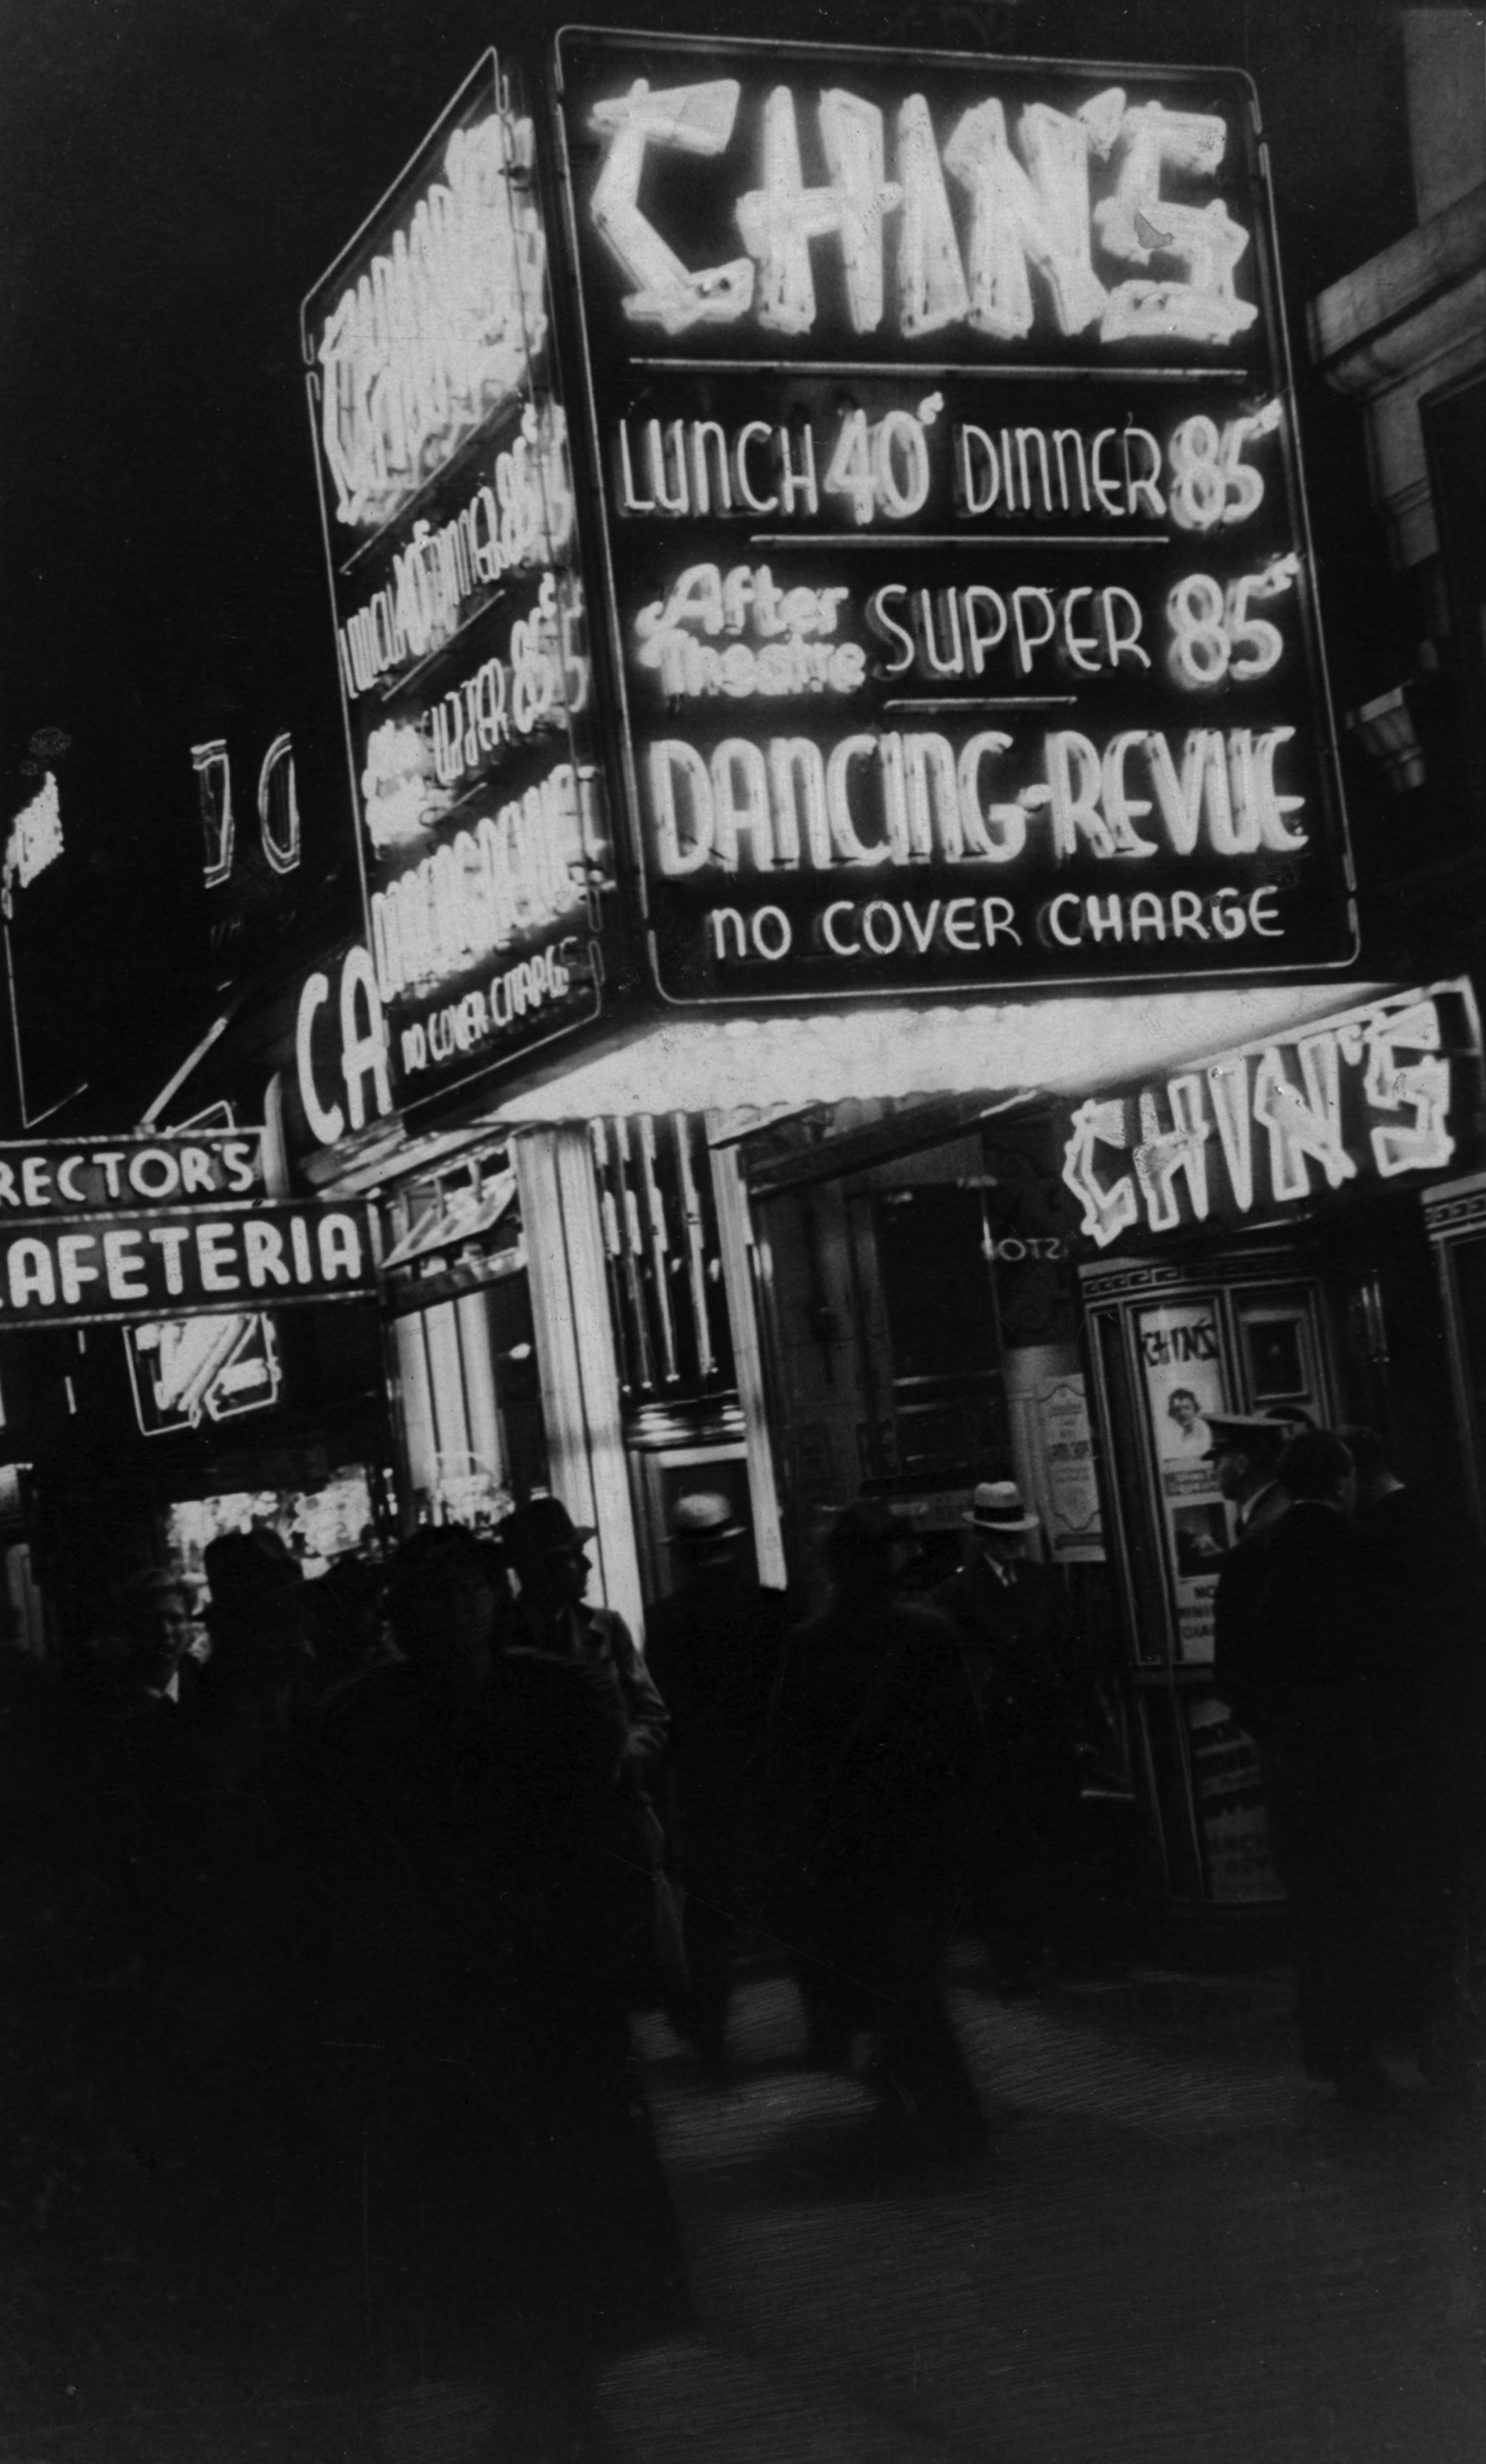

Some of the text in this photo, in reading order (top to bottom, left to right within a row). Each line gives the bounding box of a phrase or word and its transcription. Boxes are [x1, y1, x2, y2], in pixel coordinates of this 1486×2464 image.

[589, 78, 1258, 342] CHIN'S
[618, 419, 817, 517] LUNCH
[955, 424, 1167, 518] DINNER
[634, 563, 850, 637] After
[867, 583, 1152, 681] SUPPER
[710, 885, 1285, 959] NO COVER CHARGE
[1062, 1001, 1455, 1248] CHIN'S
[0, 1213, 362, 1309] AFETERIA
